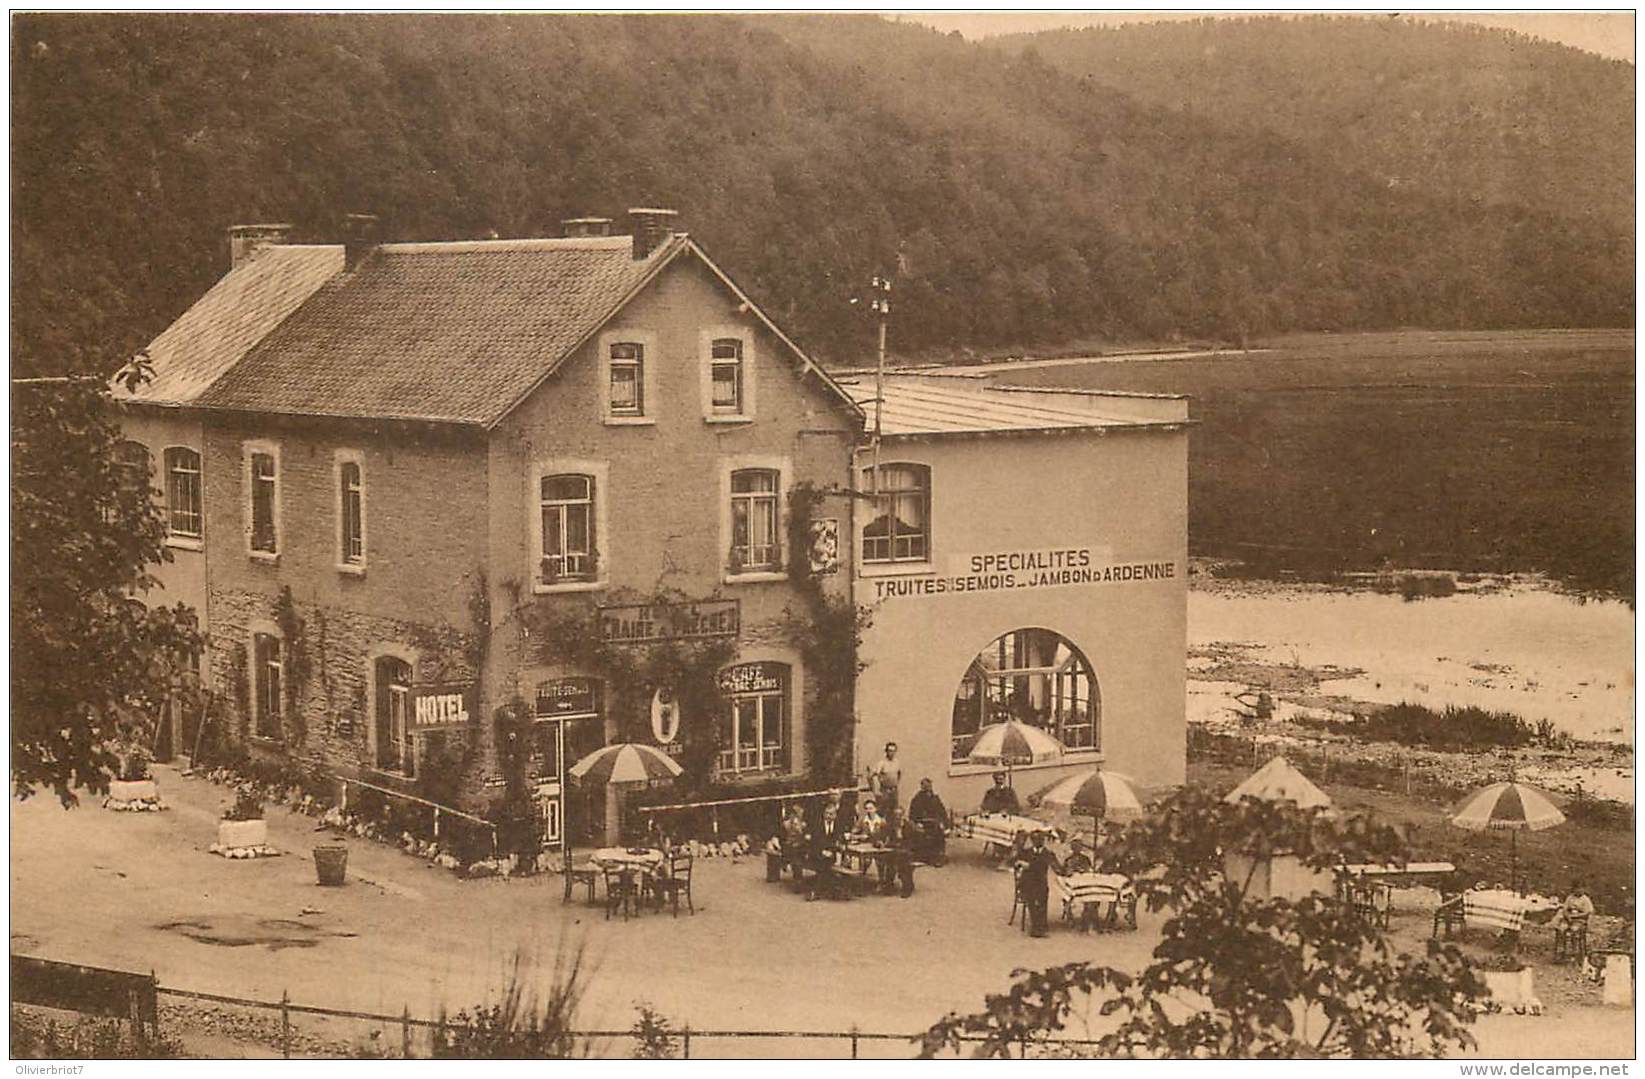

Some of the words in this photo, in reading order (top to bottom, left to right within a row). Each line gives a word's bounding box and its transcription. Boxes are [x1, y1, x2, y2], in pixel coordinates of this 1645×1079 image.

[971, 550, 1090, 573] SPECIALITES
[875, 578, 946, 597] TRUITES
[955, 574, 1016, 592] SEMOIS
[1029, 568, 1092, 587] JAMBON
[415, 693, 469, 725] HOTEL
